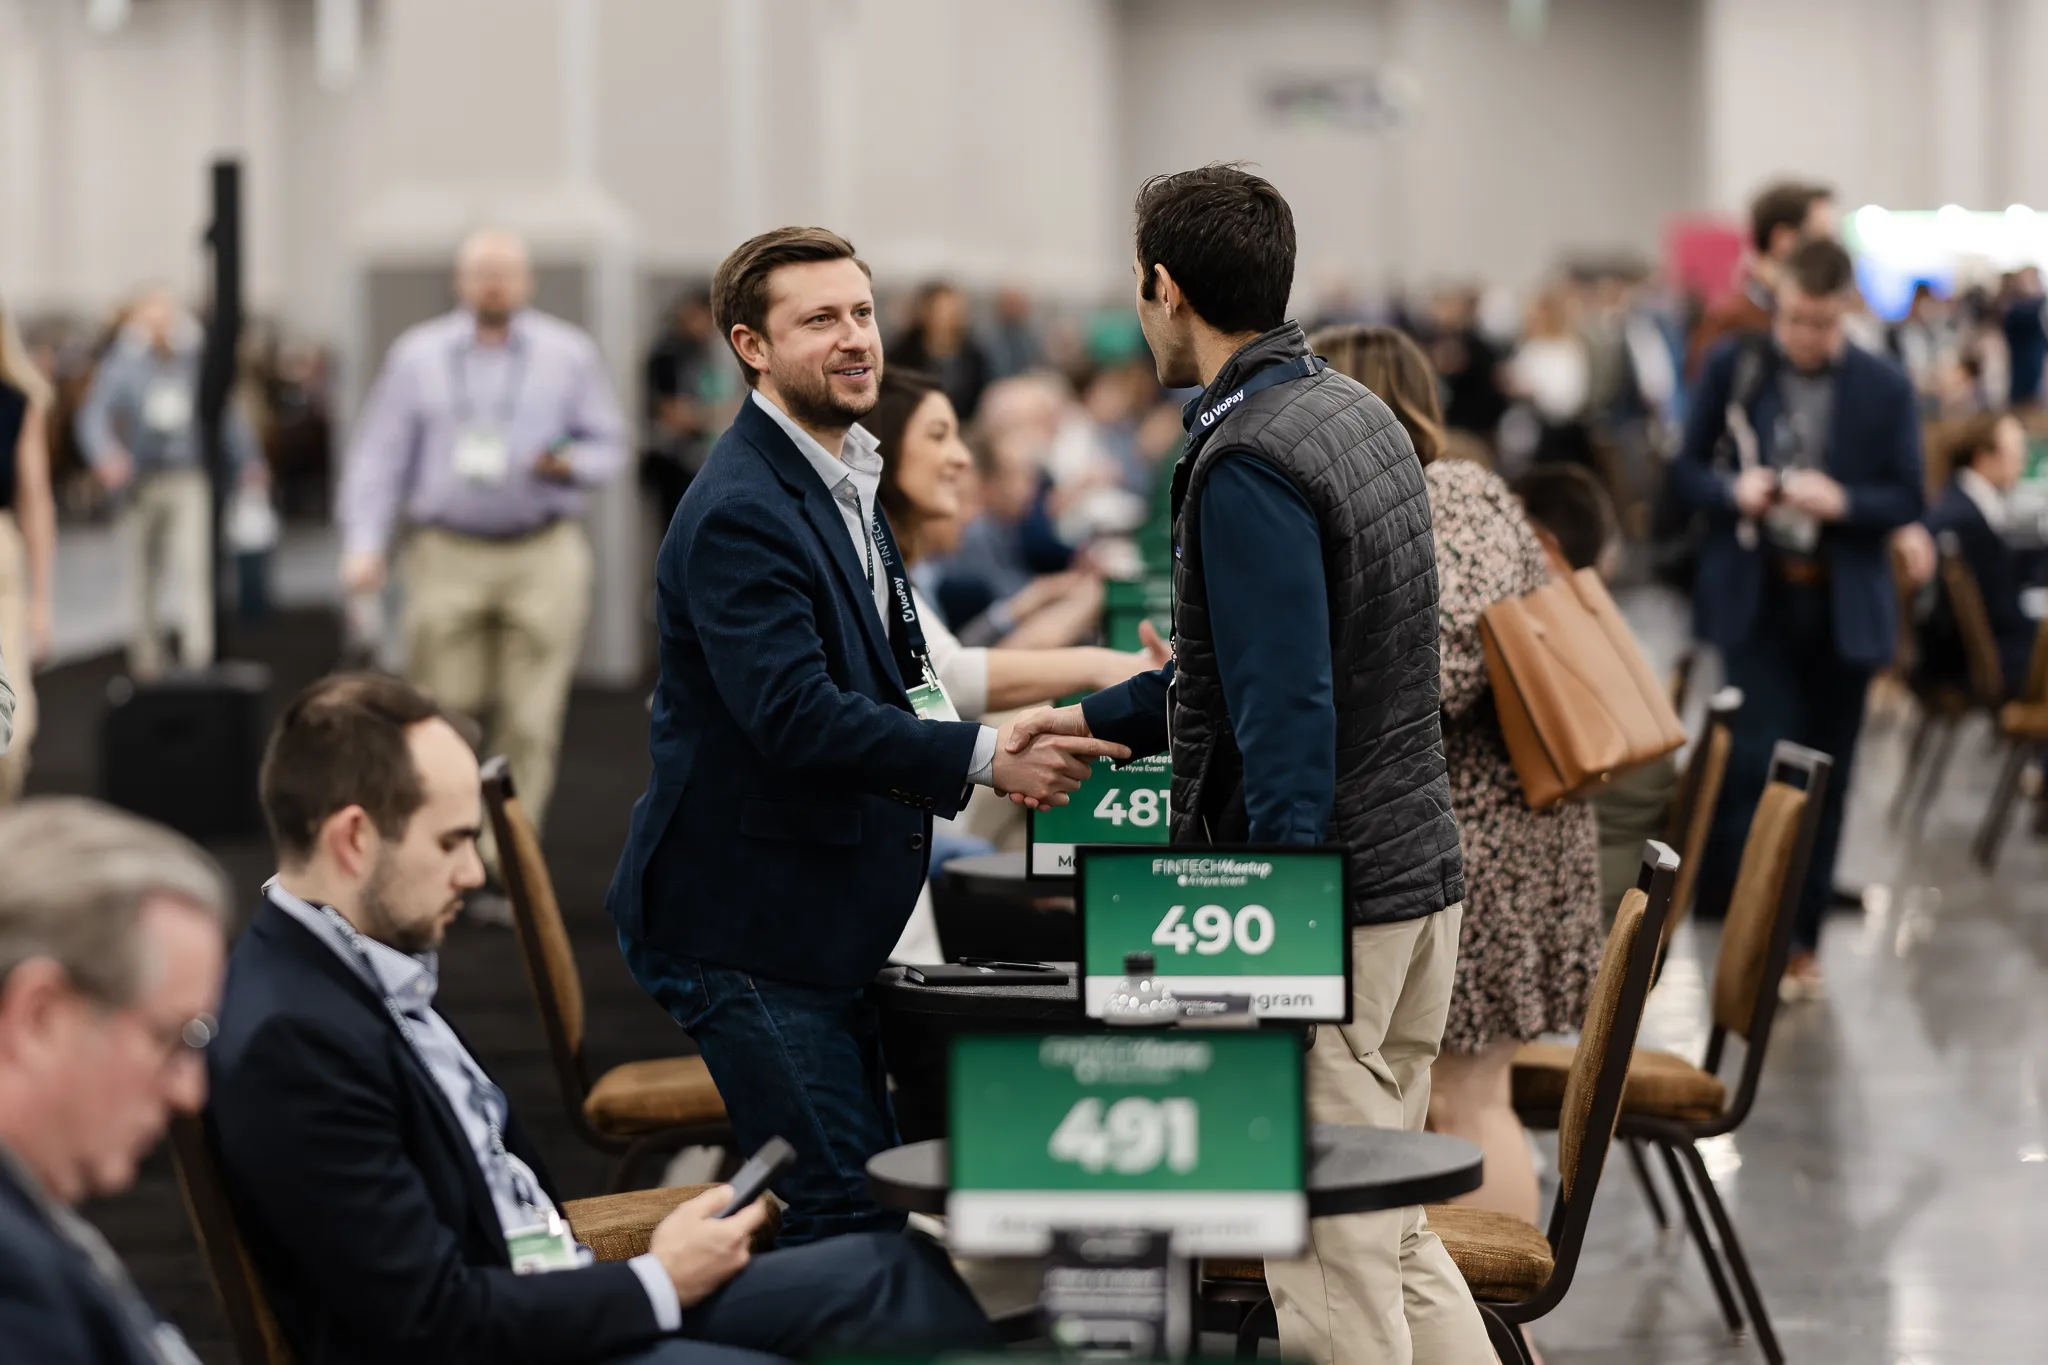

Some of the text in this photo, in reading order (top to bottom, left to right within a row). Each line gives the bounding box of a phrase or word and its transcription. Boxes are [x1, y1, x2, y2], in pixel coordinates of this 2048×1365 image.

[1212, 389, 1244, 416] VoPay
[893, 577, 911, 611] VoPay
[1093, 788, 1171, 827] 481
[1058, 855, 1076, 867] M
[1151, 903, 1276, 956] 490
[1047, 1097, 1200, 1175] 491
